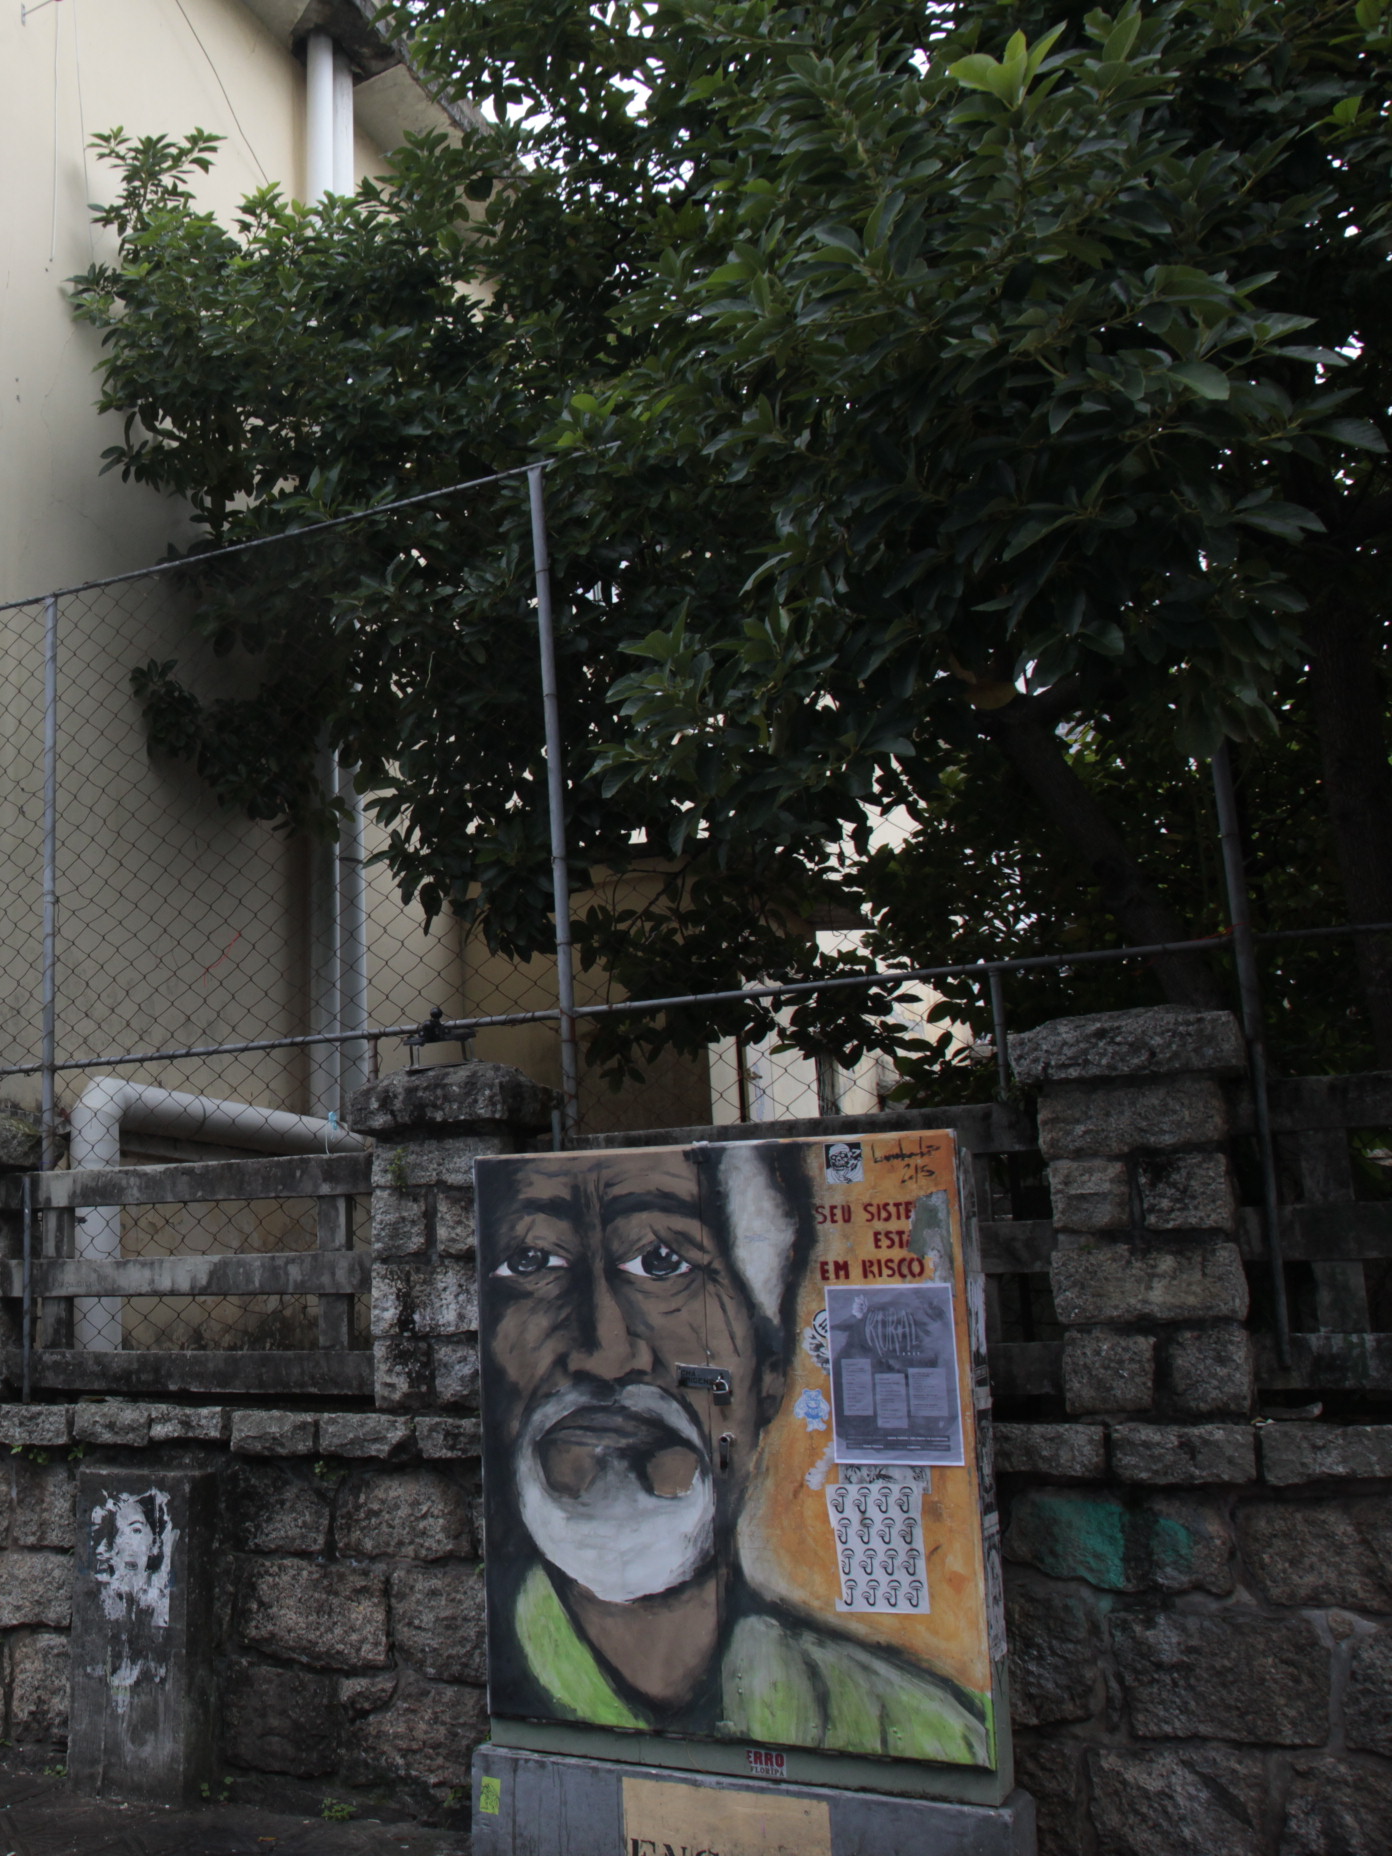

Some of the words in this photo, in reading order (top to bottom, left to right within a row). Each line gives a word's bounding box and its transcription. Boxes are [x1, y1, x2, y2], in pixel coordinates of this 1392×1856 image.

[815, 1204, 852, 1224] SEU
[819, 1260, 850, 1281] EM
[862, 1257, 925, 1279] RISCO
[746, 1749, 786, 1768] ERRO
[750, 1765, 785, 1777] FLORIPA
